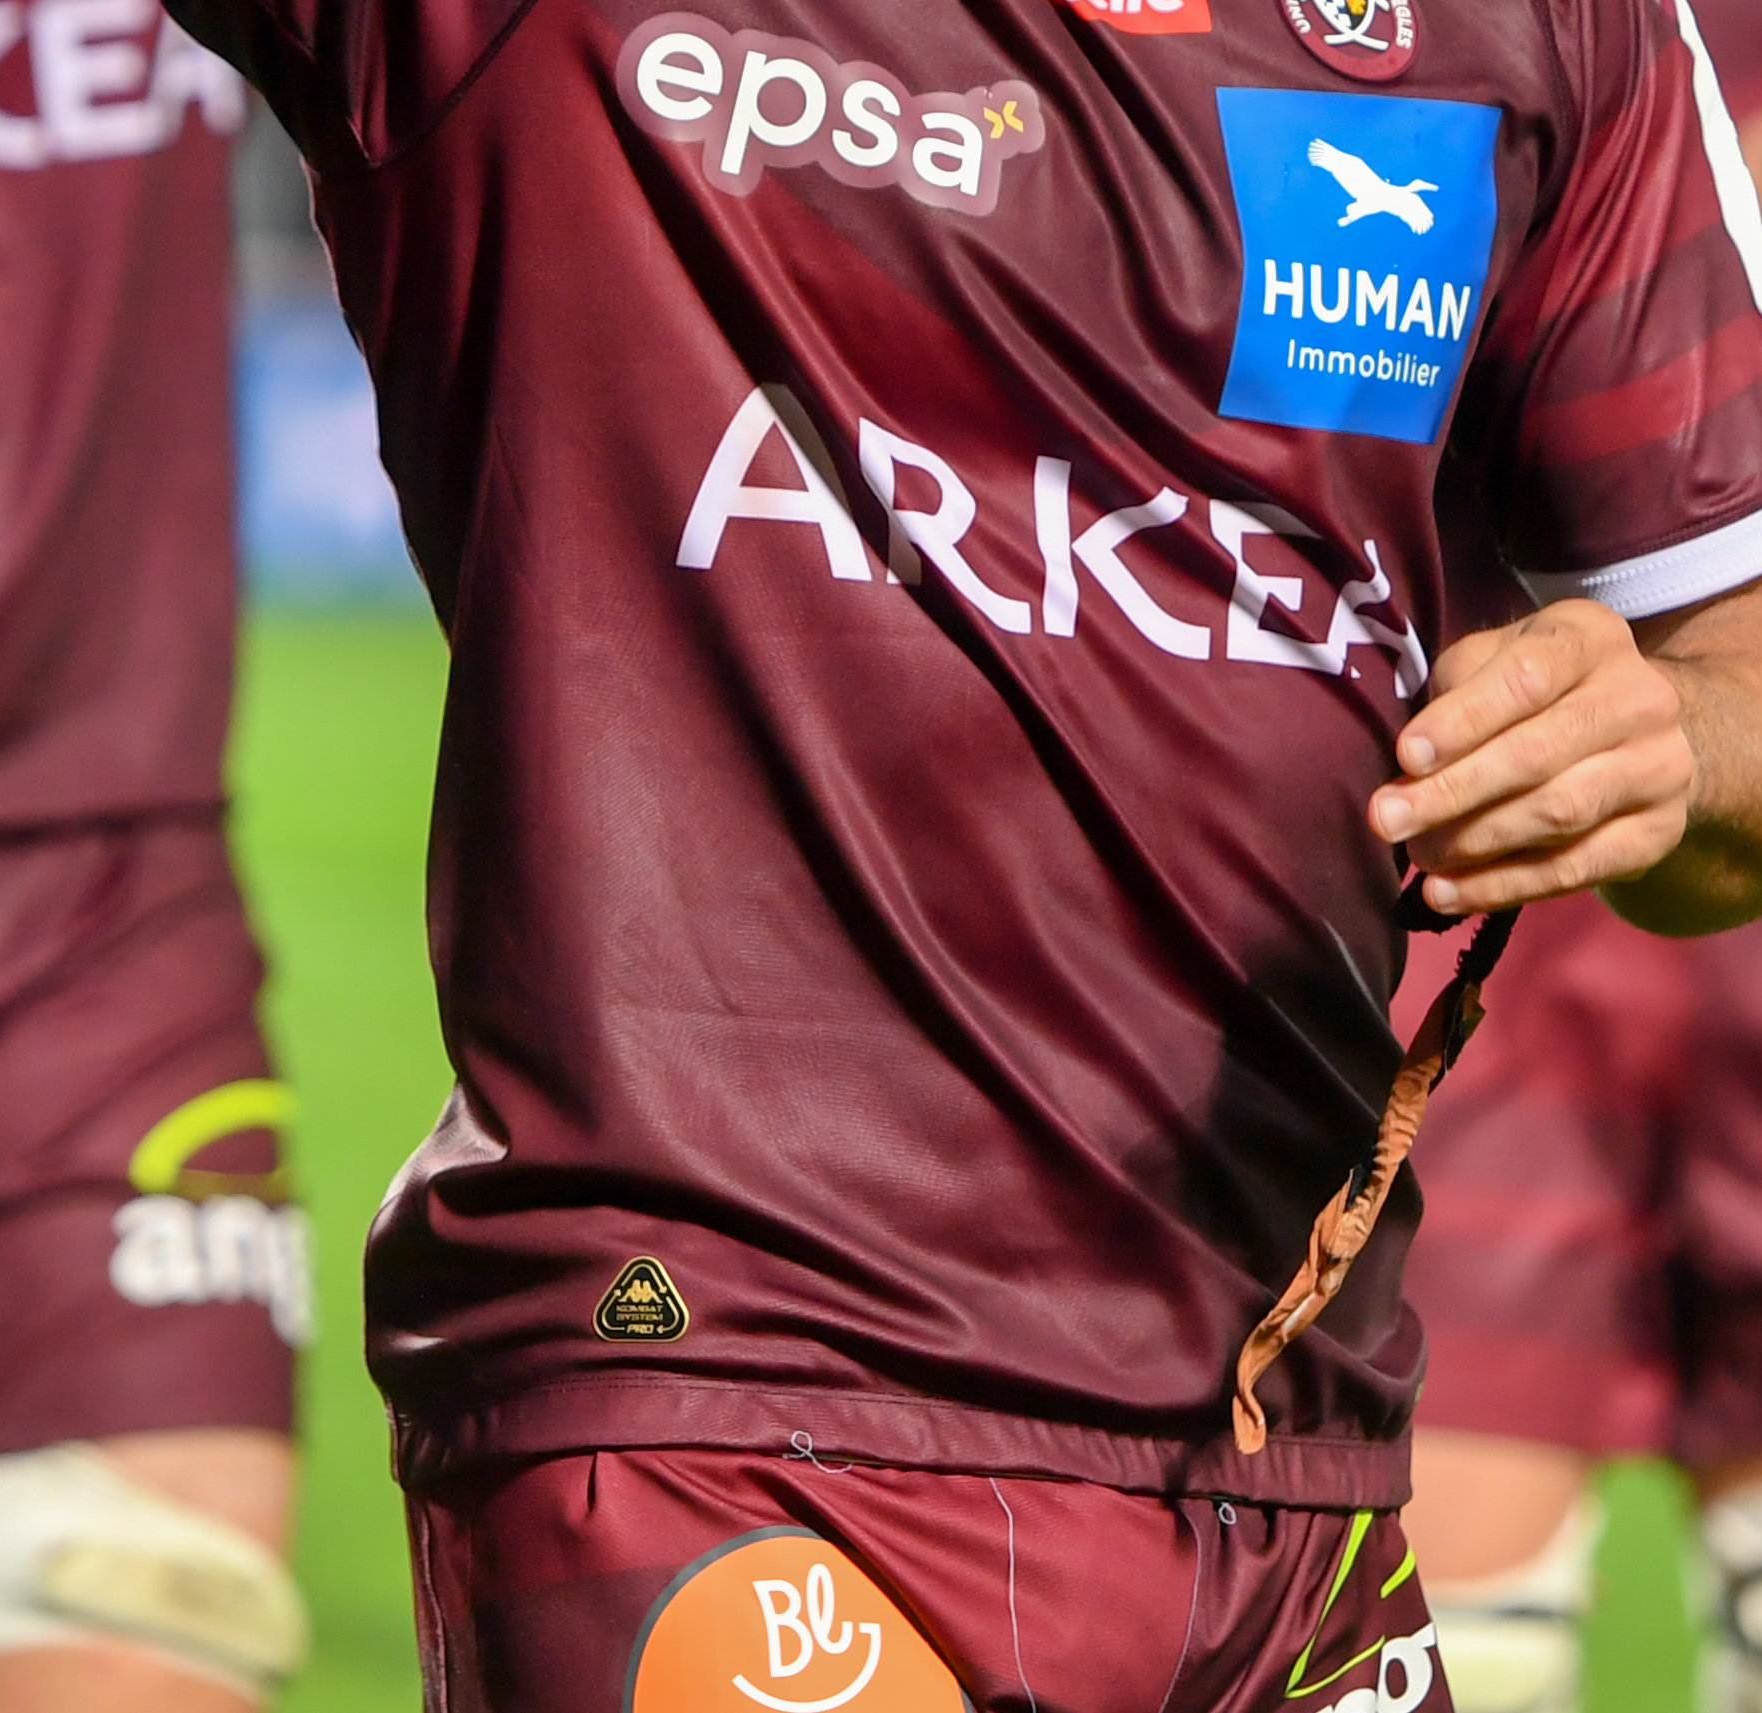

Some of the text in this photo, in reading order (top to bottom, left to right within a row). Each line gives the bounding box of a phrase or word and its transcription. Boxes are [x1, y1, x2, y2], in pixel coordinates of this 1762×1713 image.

[635, 30, 990, 196] epsa
[1262, 258, 1472, 342] HUMAN
[1286, 338, 1441, 389] Immobilier
[674, 382, 1430, 699] ARKEA
